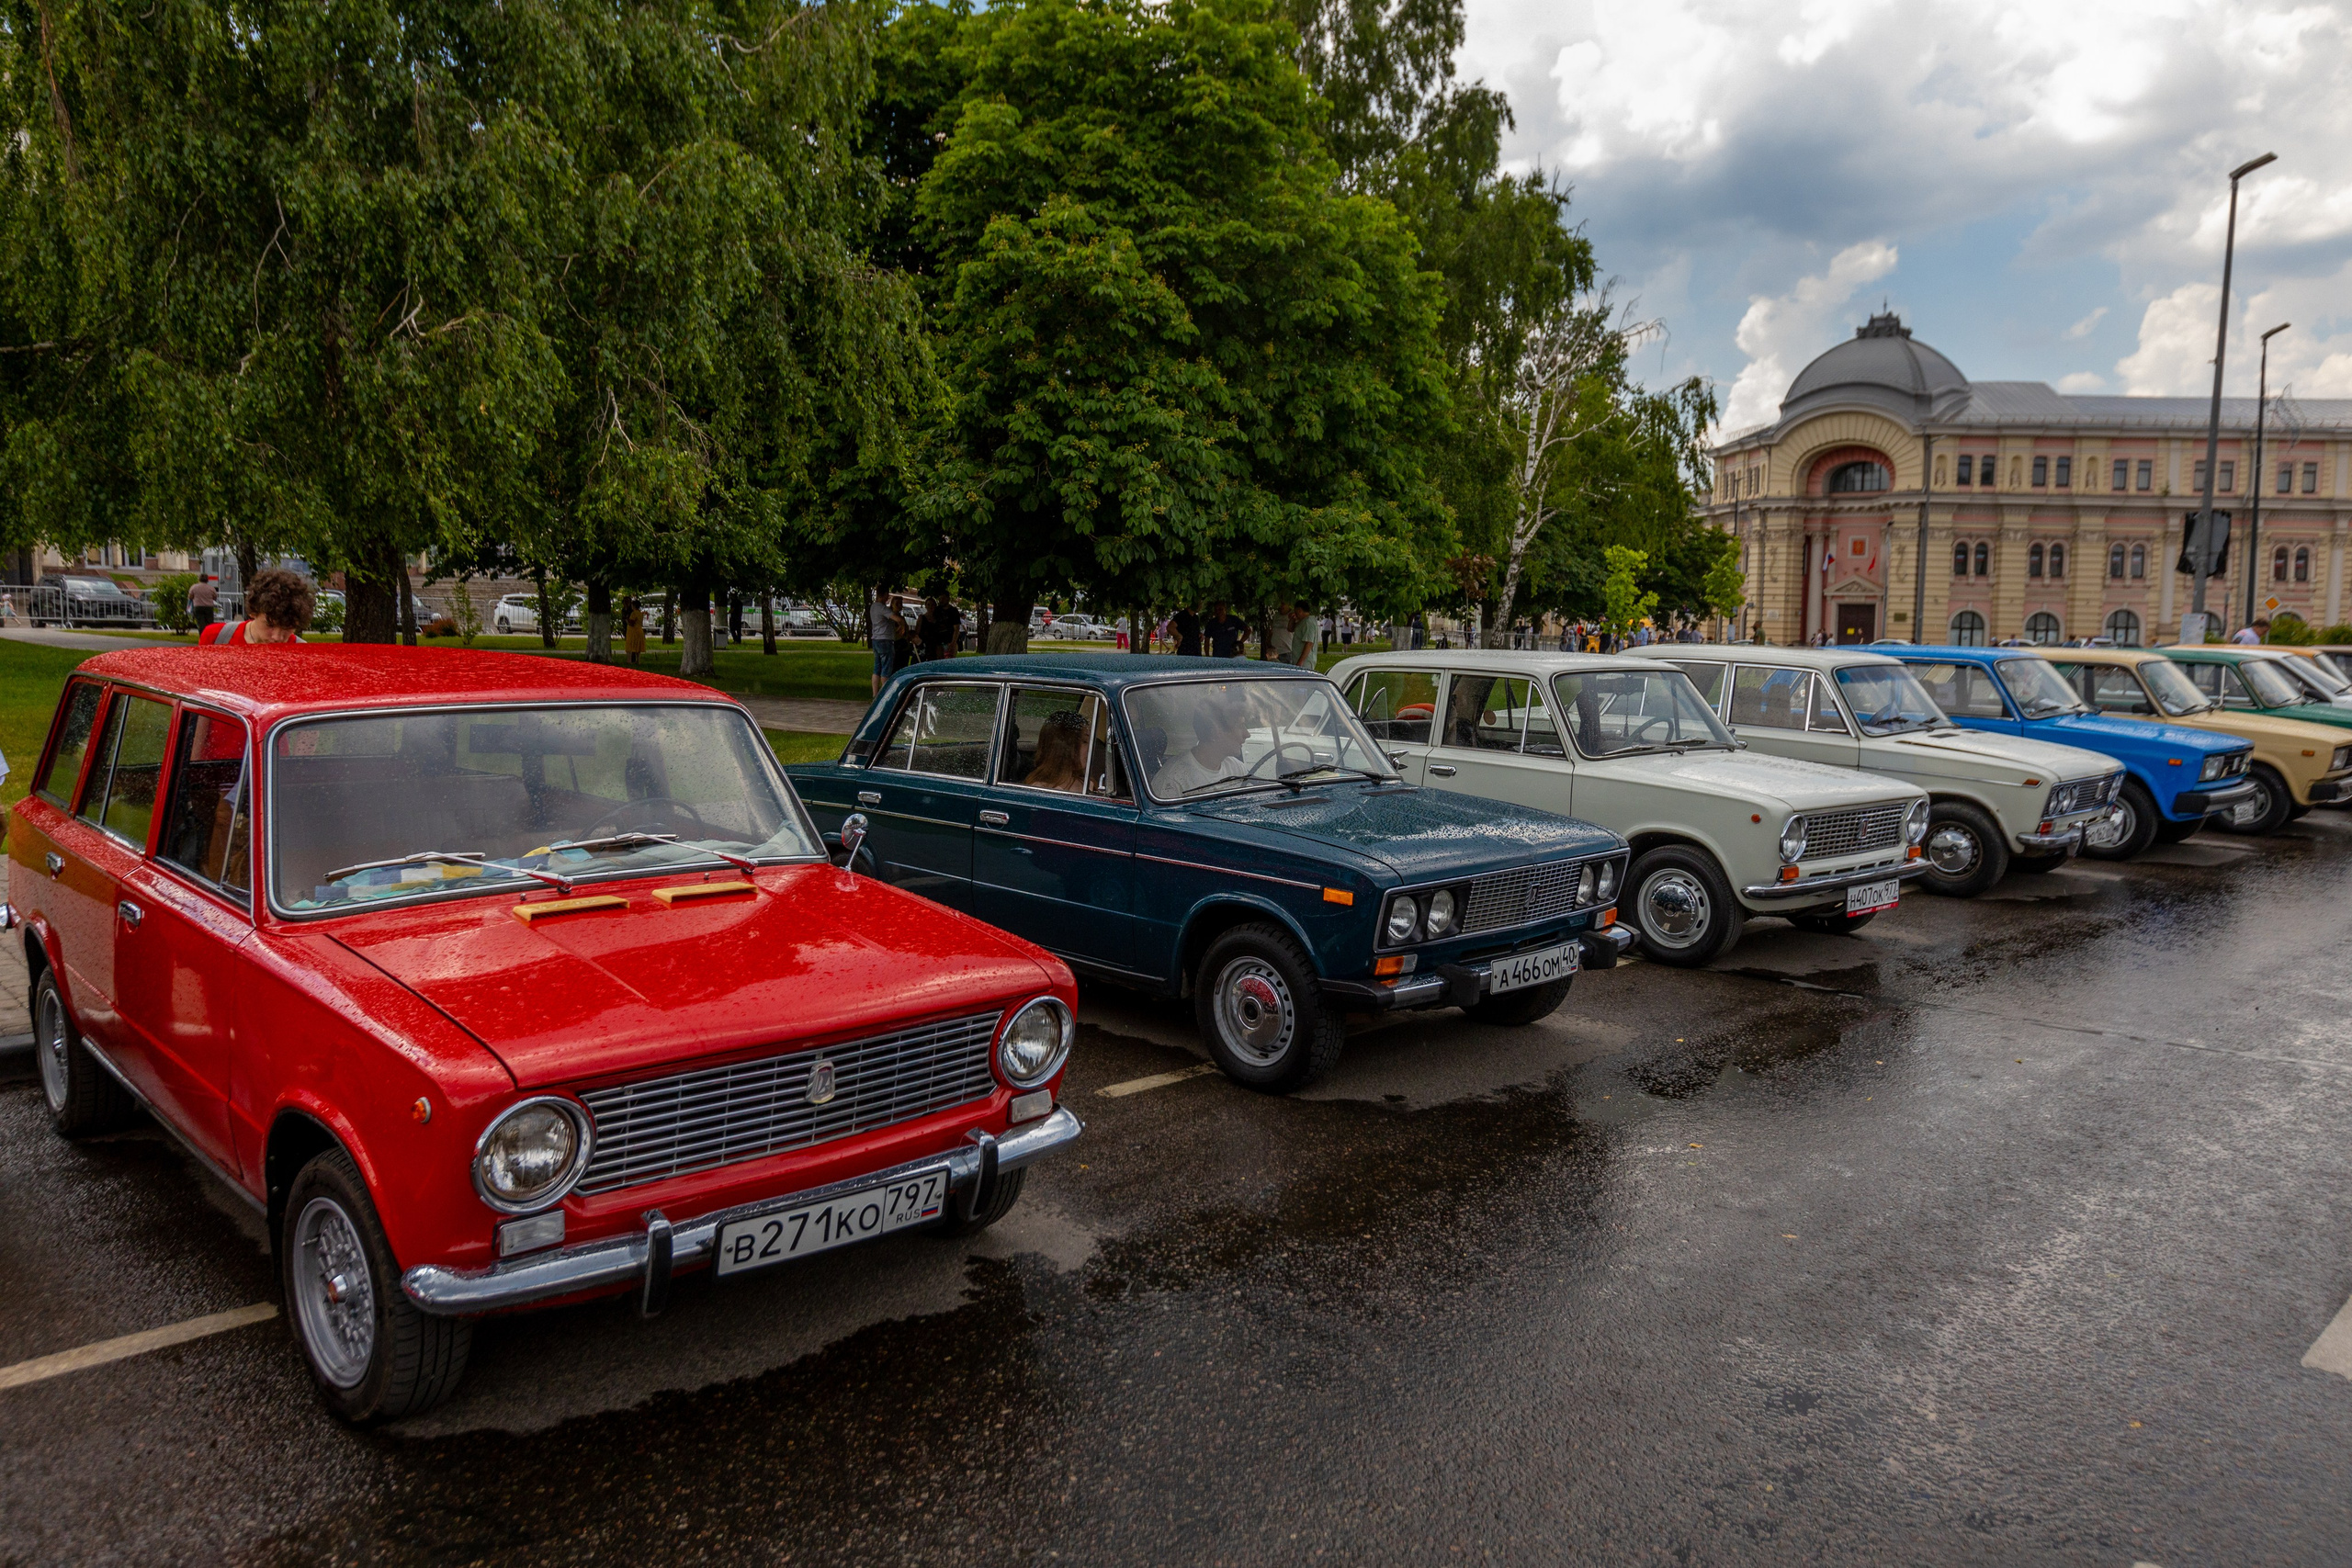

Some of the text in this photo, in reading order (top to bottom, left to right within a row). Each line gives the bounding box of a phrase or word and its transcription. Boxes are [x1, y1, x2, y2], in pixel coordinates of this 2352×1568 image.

[1885, 882, 1897, 897] 977
[1563, 945, 1575, 965] 40
[733, 1177, 937, 1265] В271КО 797
[896, 1209, 920, 1224] RUS
